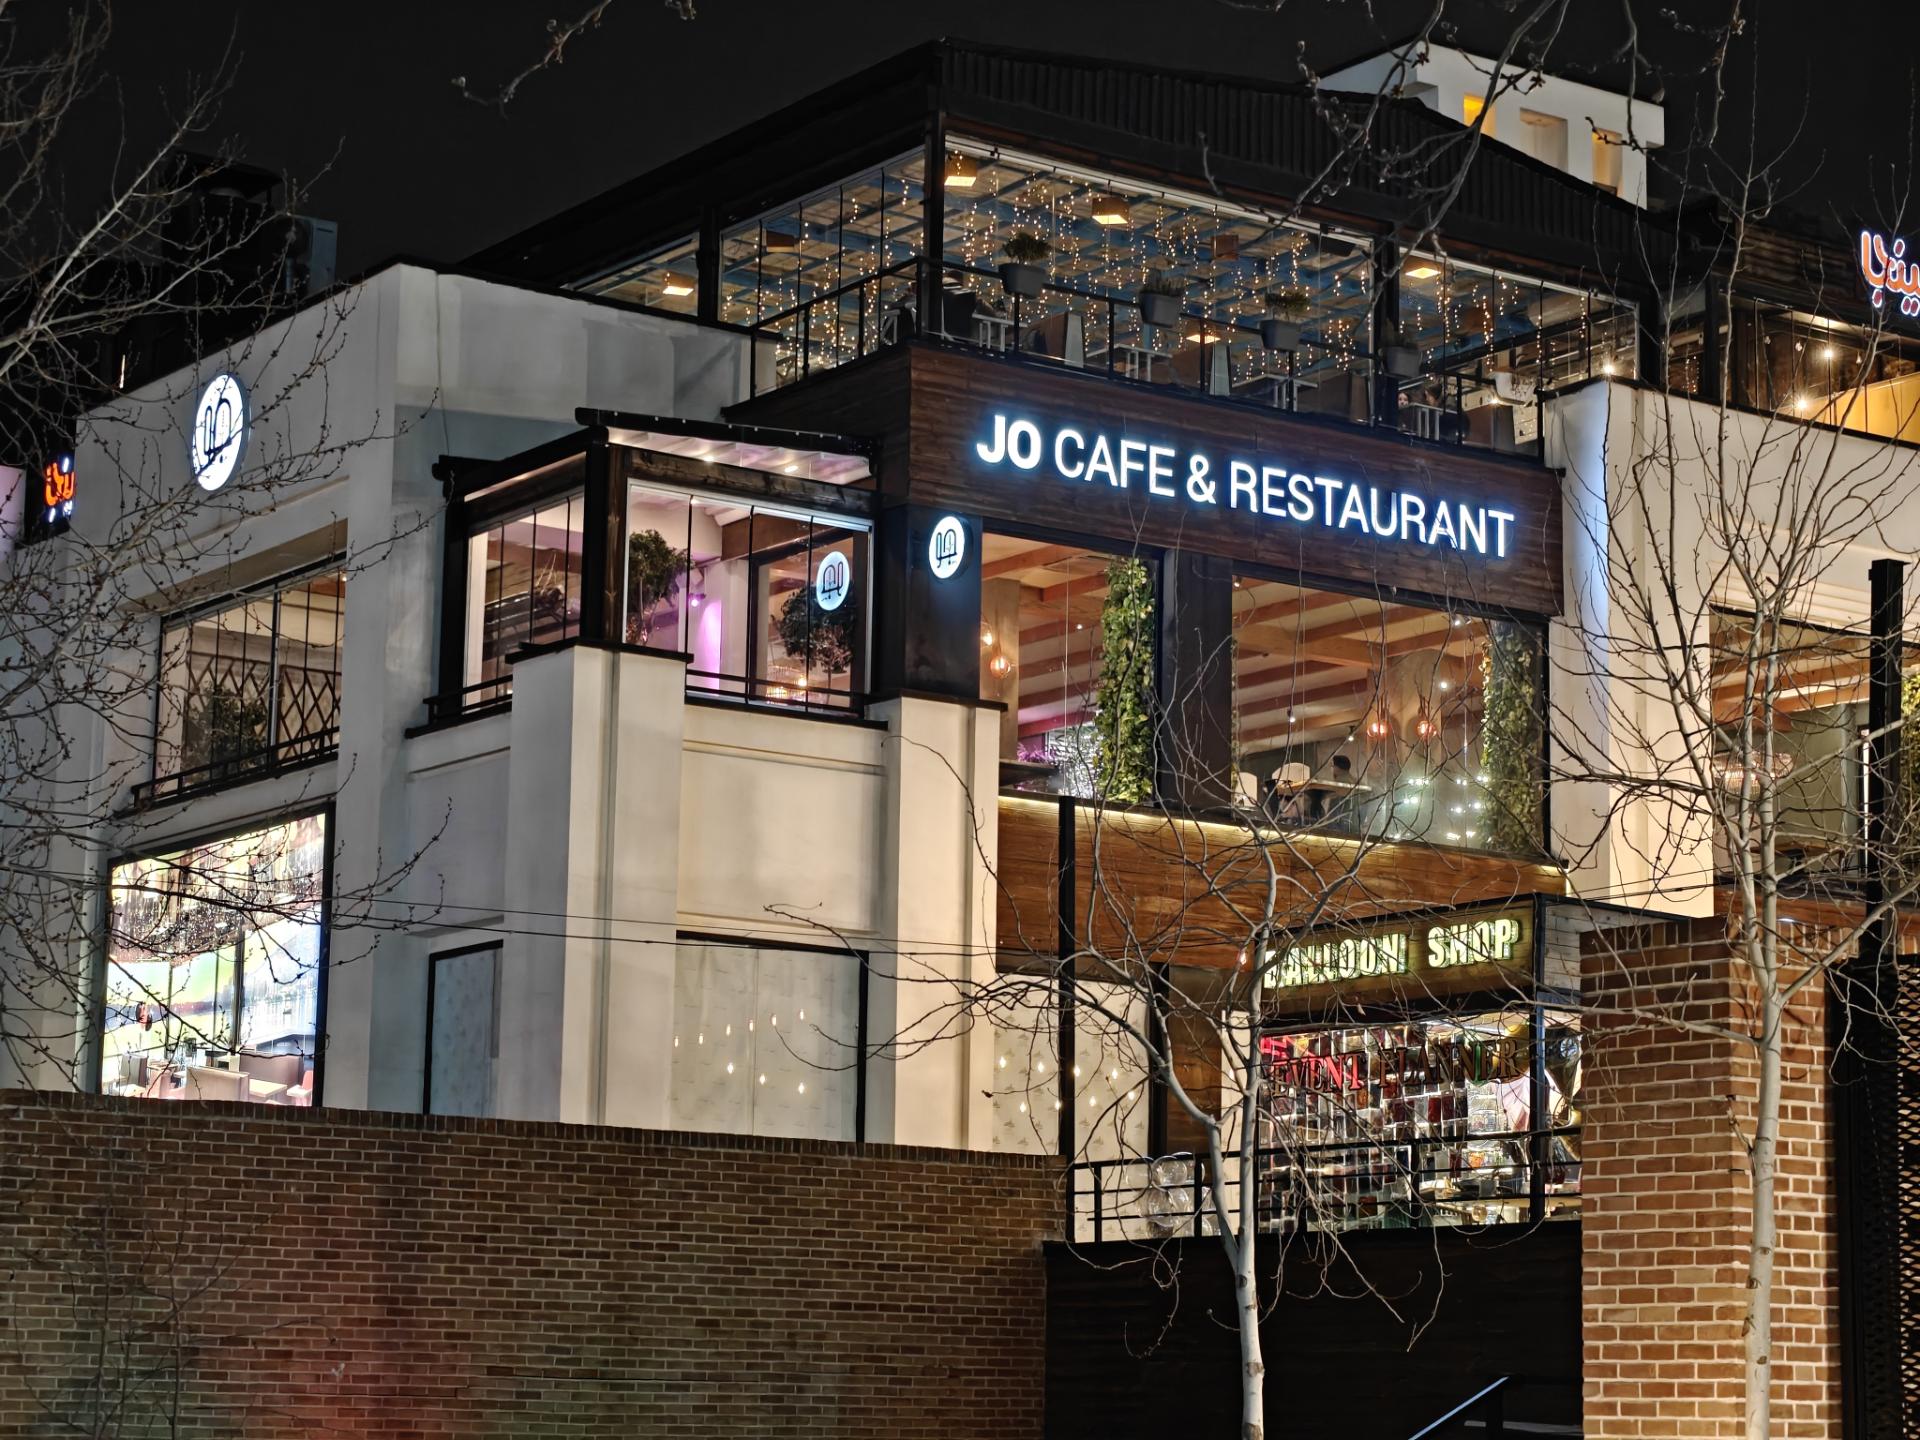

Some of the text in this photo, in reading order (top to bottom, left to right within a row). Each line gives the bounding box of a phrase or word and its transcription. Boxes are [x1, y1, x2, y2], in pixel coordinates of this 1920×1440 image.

[977, 413, 1516, 558] JO CAFE & RESTAURANT
[1428, 918, 1519, 968] SHOP
[1271, 1038, 1519, 1097] EVENT PLANNER
